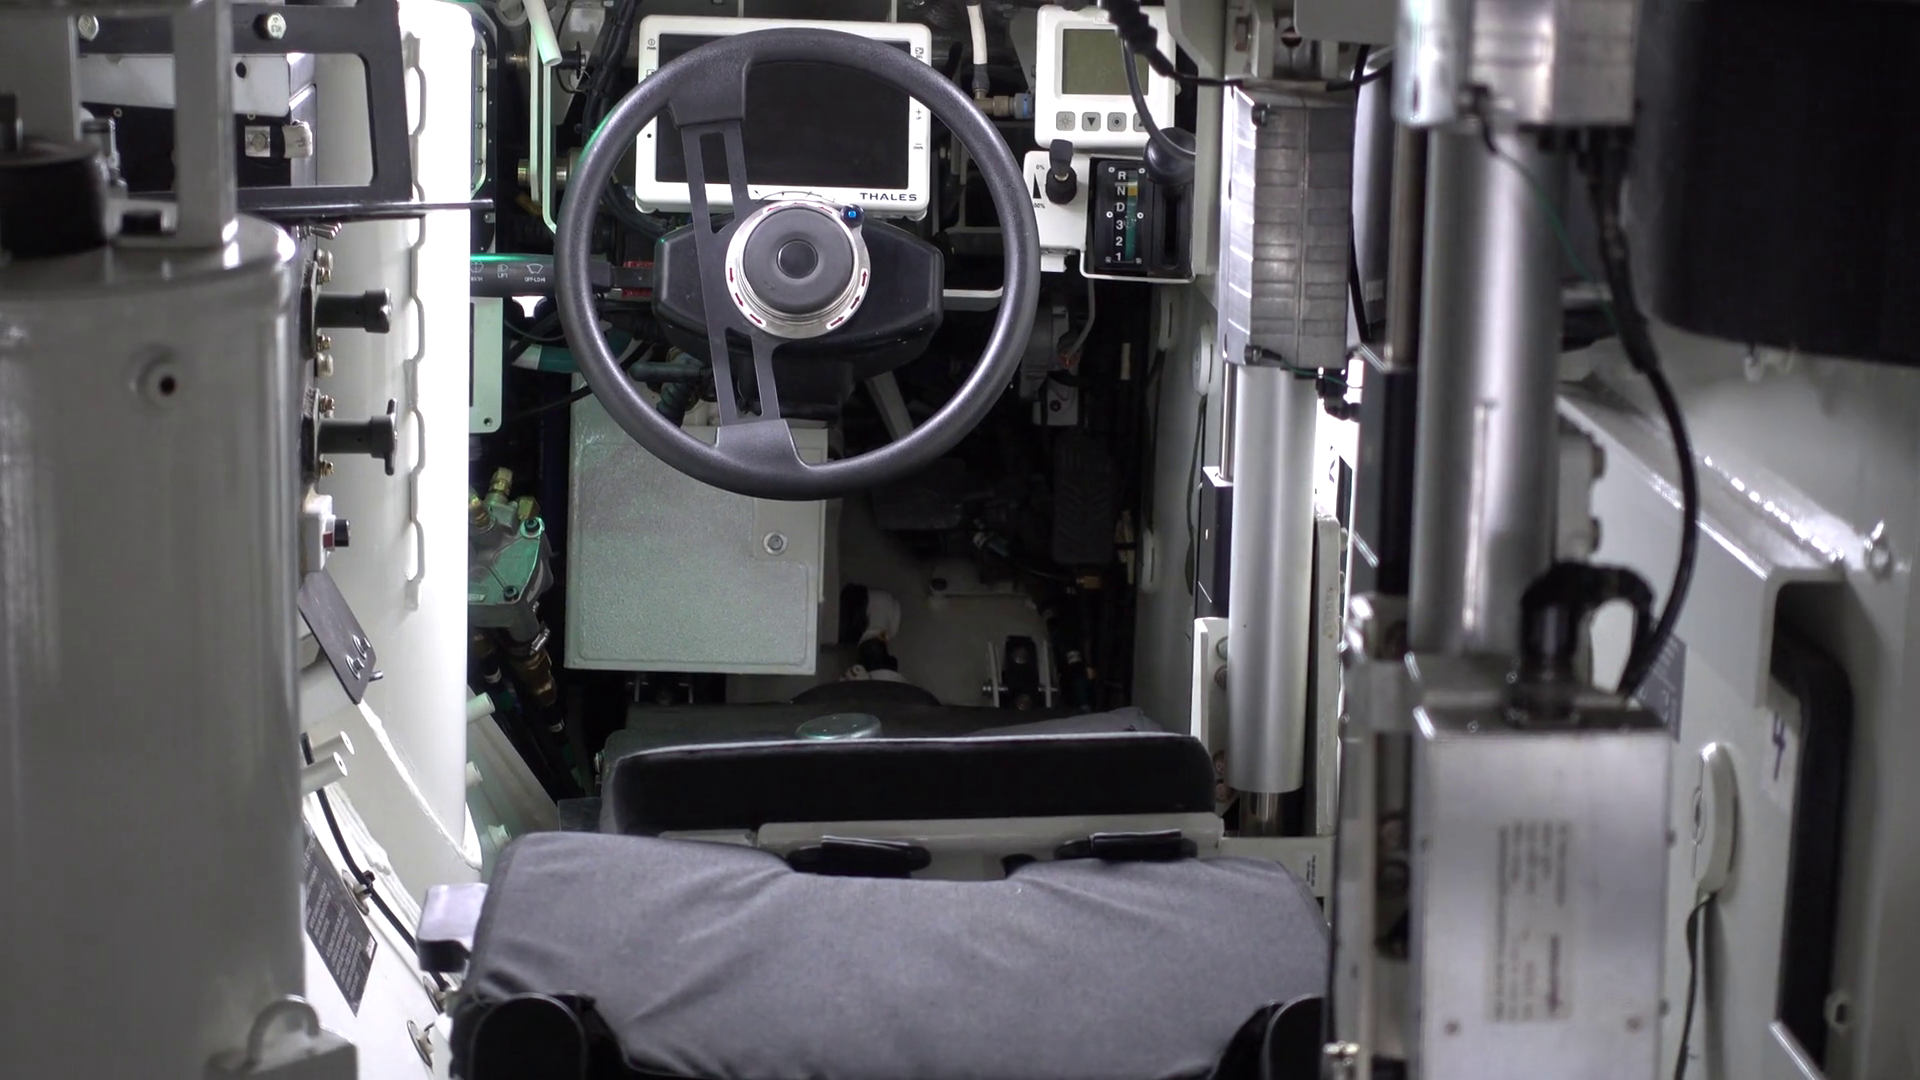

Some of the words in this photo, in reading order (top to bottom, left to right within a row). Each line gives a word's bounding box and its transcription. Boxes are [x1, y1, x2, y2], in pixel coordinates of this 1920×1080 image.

[1118, 171, 1127, 180] R
[1117, 186, 1126, 196] N
[859, 192, 917, 201] THALES
[1116, 202, 1126, 212] D
[1116, 220, 1124, 230] 3
[1115, 236, 1123, 247] 2
[1115, 252, 1122, 261] 1
